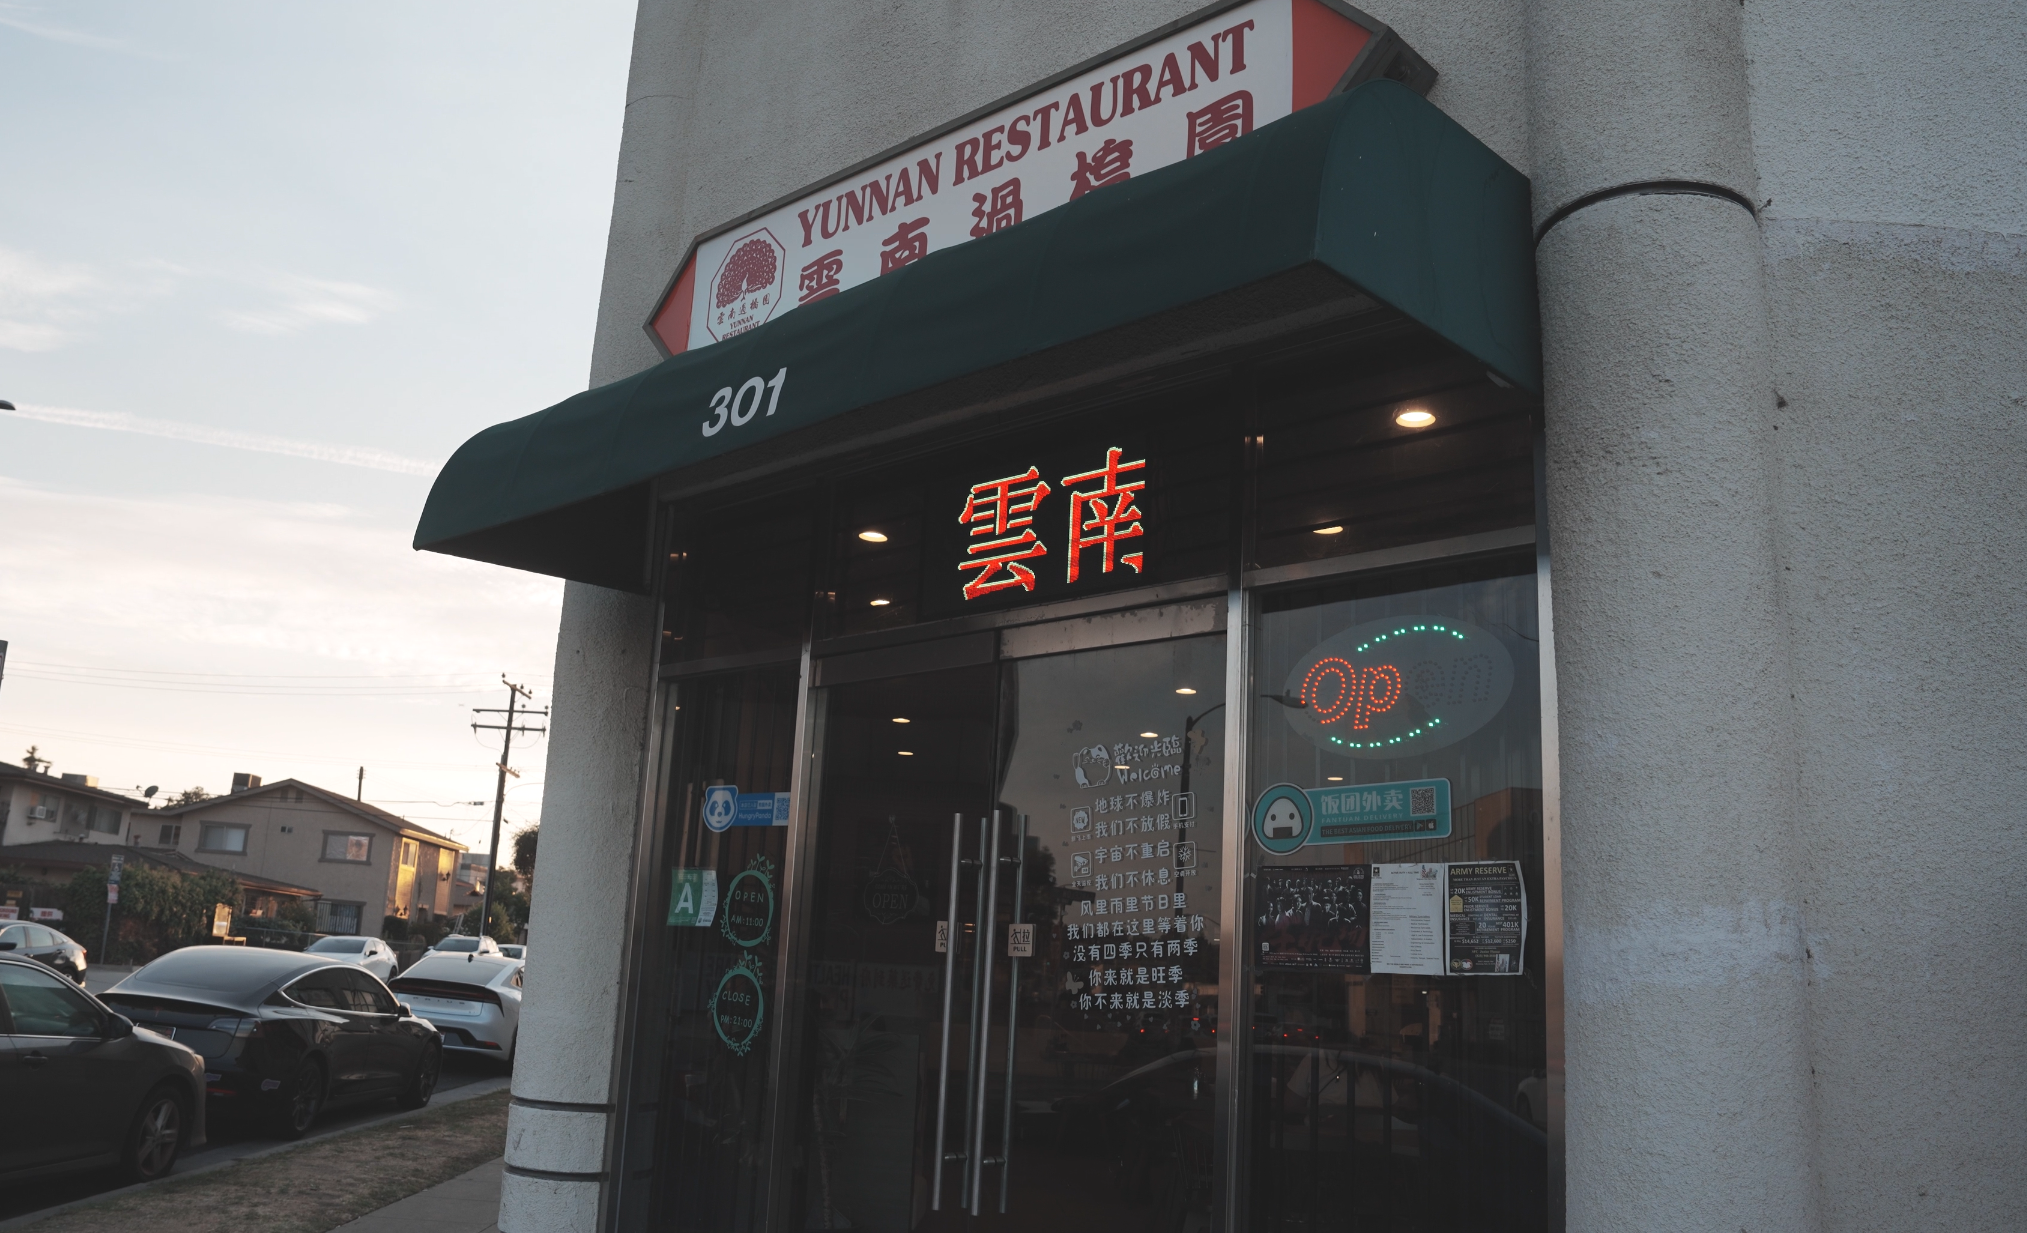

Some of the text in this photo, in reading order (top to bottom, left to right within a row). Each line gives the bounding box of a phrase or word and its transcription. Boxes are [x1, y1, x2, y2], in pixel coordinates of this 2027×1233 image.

[798, 19, 1254, 248] YUNNAN RESTAURANT
[729, 315, 754, 330] YUNNAN
[702, 367, 787, 437] 301
[958, 446, 1146, 600] 雲南
[1117, 763, 1181, 785] Welcome
[1094, 789, 1171, 814] 地球不爆炸
[1320, 789, 1404, 815] 饭团外卖
[738, 811, 772, 821] HungryPanda
[1095, 813, 1171, 838] 我们不放假
[1321, 813, 1403, 823] FANTUAN DELIVERY
[1095, 839, 1171, 864] 宇宙不重启
[1095, 867, 1172, 891] 我们不休息
[1450, 866, 1507, 875] ARMY RESERVE
[674, 882, 694, 914] A
[735, 890, 765, 904] OPEN
[872, 892, 909, 909] OPEN
[1080, 892, 1187, 916] 风里雨里节日里
[731, 914, 764, 927] AM:11:00
[1067, 914, 1204, 940] 我们都在这里等着你
[1022, 929, 1030, 942] 拉
[1073, 937, 1198, 962] 没有四季只有两季
[1089, 965, 1183, 987] 你来就是旺季
[722, 990, 750, 1006] CLOSE
[1079, 989, 1190, 1010] 你不来就是淡季
